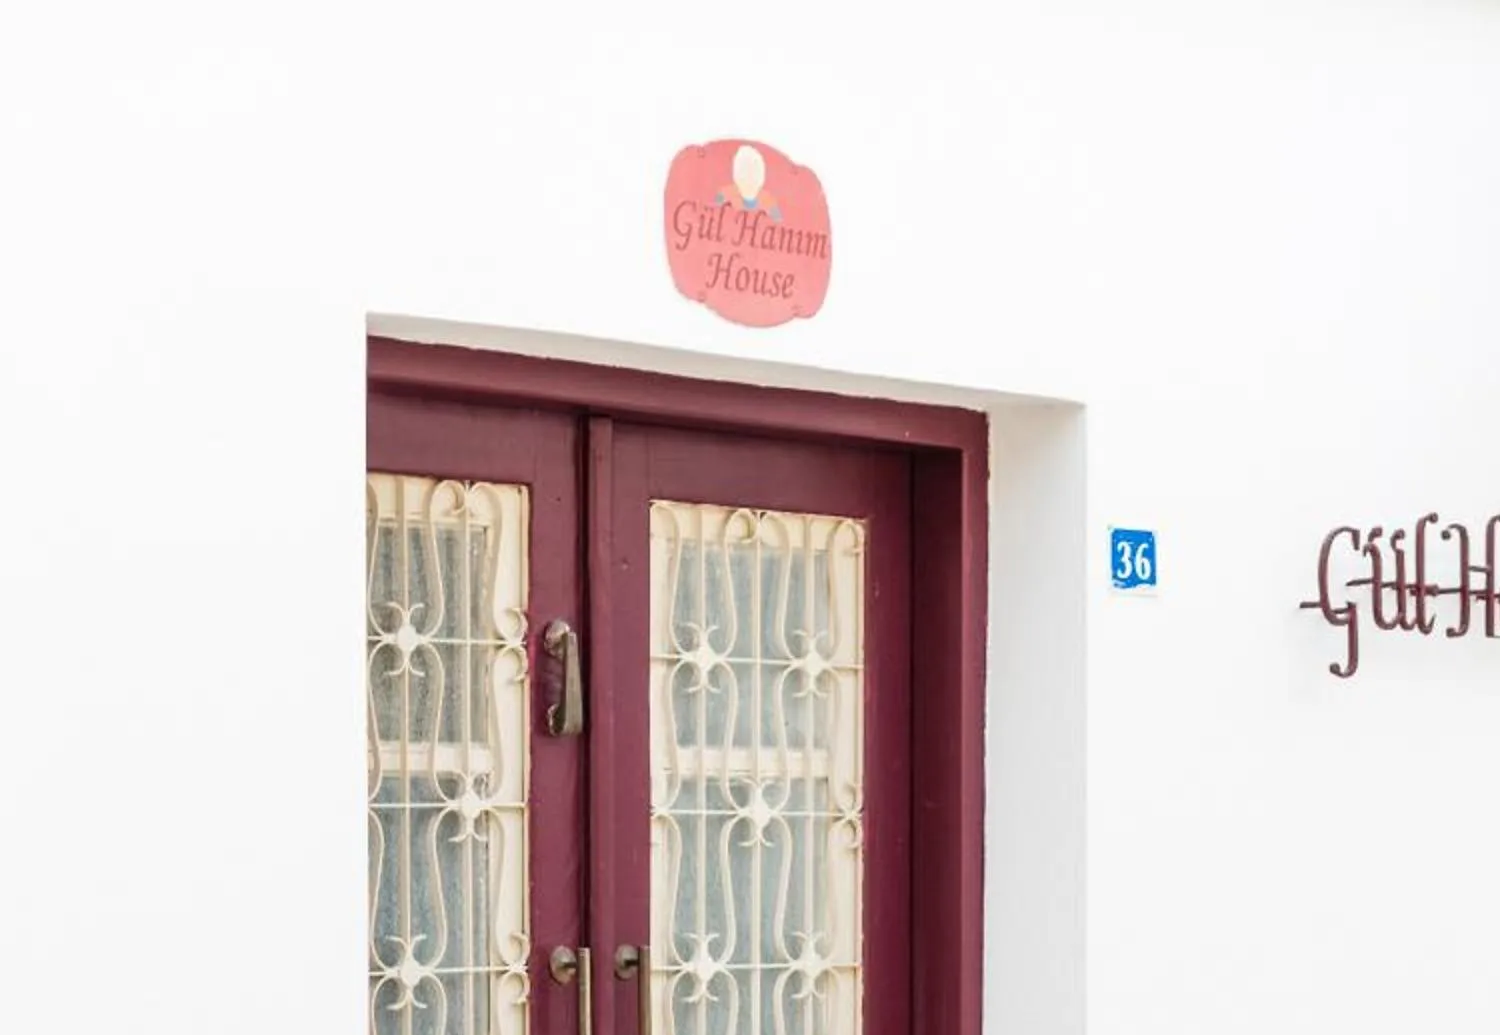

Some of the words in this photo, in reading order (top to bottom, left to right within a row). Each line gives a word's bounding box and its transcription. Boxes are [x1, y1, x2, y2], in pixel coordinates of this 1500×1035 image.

[673, 200, 732, 251] Gül
[706, 252, 795, 299] House
[1117, 541, 1151, 580] 36
[1317, 512, 1438, 678] Gül
